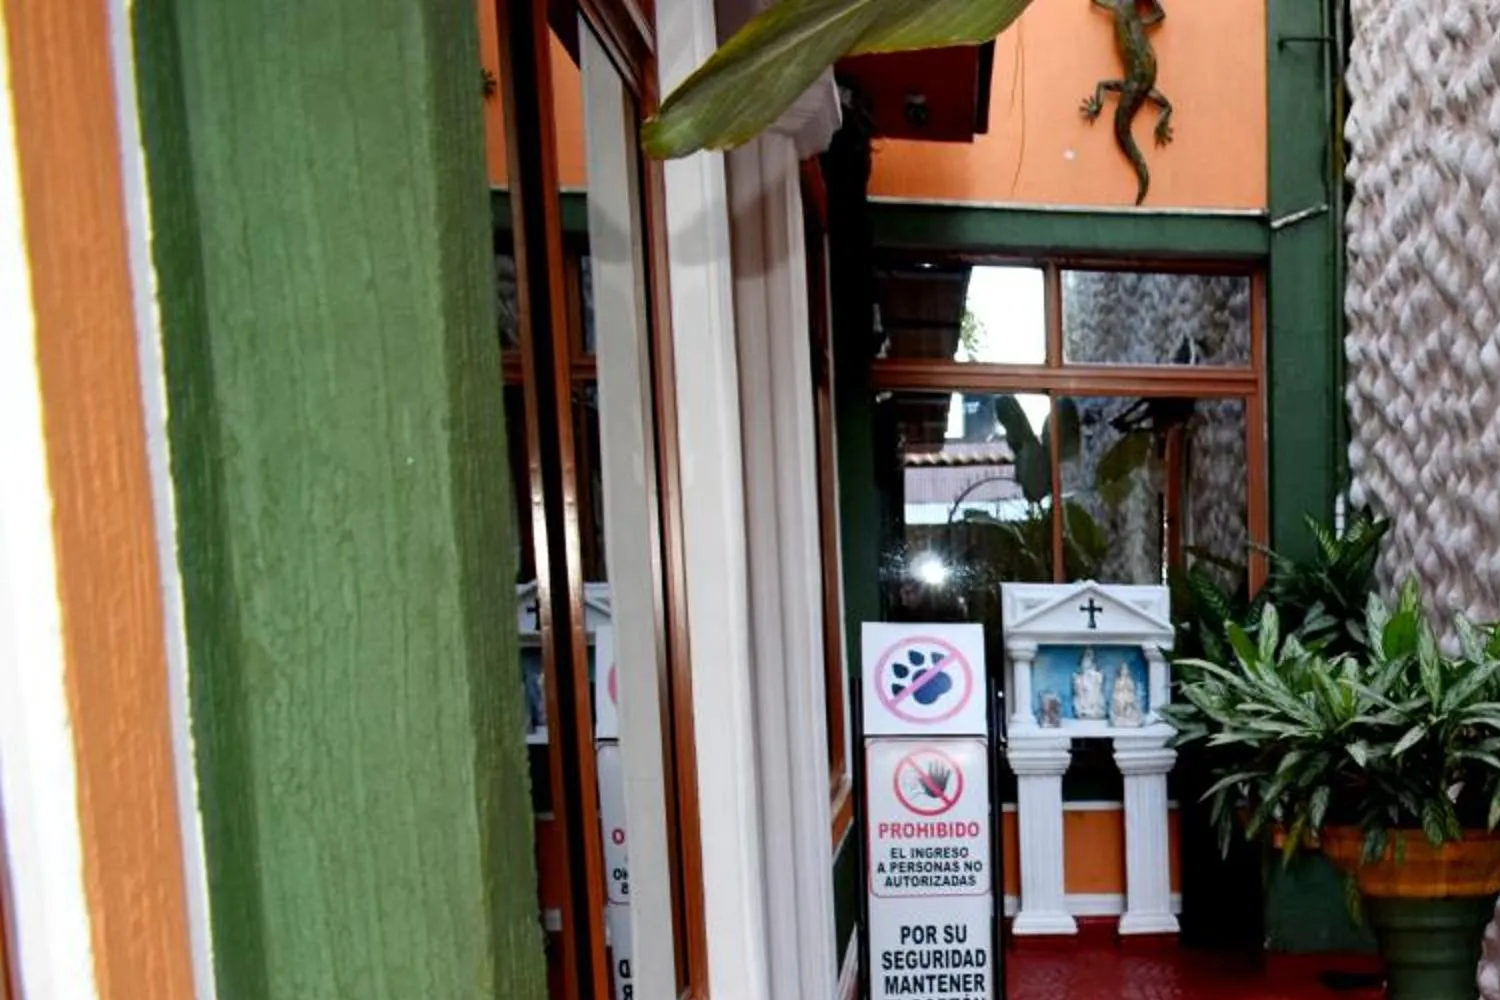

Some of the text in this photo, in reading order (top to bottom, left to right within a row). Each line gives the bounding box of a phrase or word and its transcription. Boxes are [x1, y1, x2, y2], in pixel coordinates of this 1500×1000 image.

[879, 822, 979, 838] PROHIBIDO
[891, 847, 969, 858] EL INGRESO
[877, 861, 983, 873] A PERSONAS NO
[885, 875, 976, 887] AUTORIZADAS
[900, 924, 967, 945] POR SU
[882, 949, 986, 970] SEGURIDAD
[885, 974, 985, 994] MANTENER
